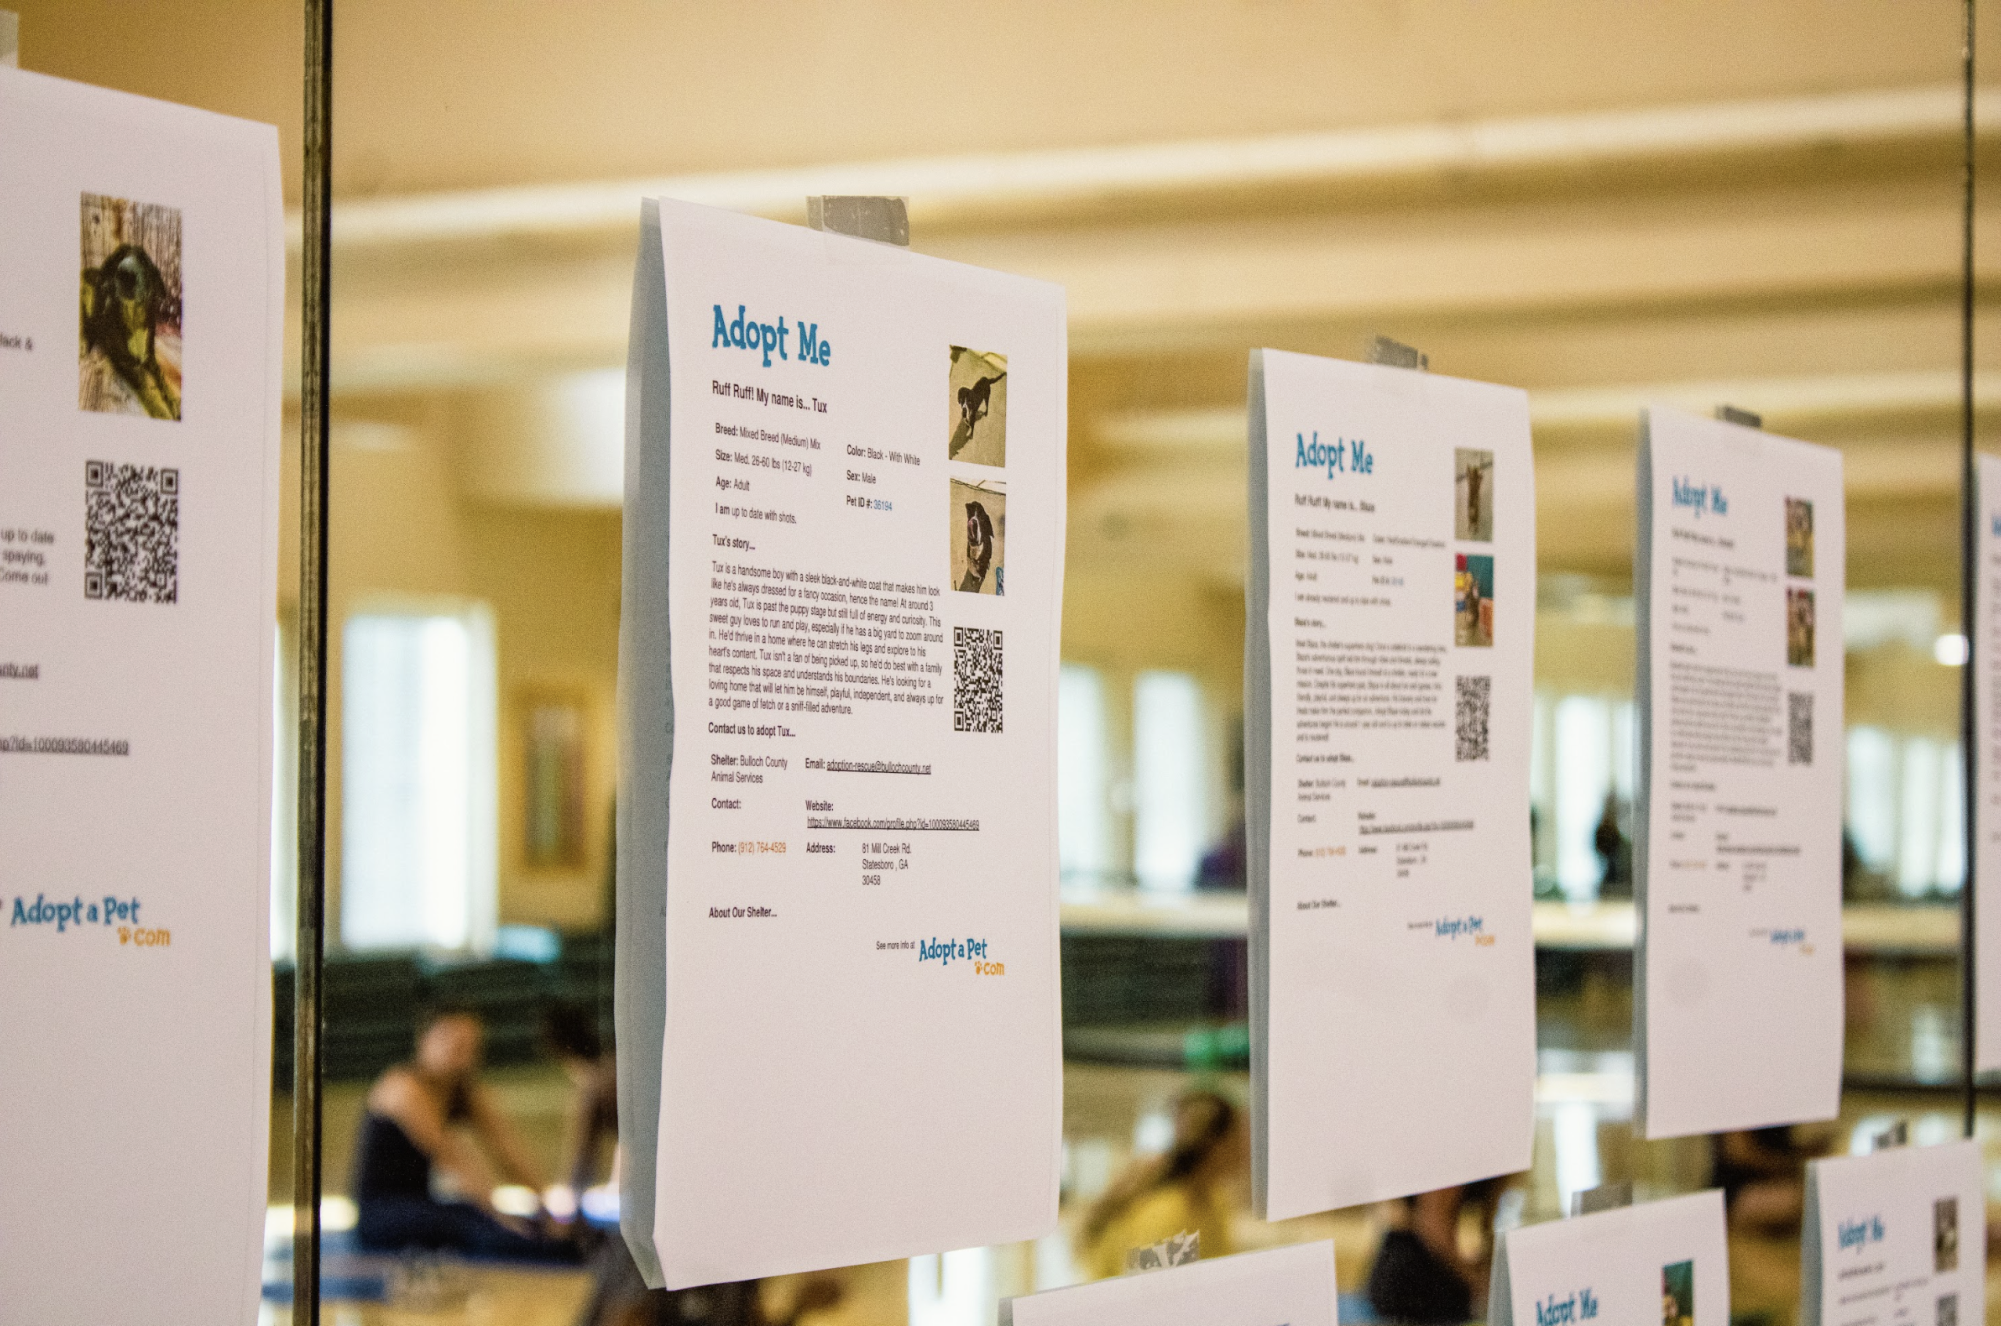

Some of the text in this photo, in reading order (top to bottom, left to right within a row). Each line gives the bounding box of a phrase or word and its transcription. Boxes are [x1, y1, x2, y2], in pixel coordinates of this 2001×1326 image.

[712, 305, 830, 367] Adopt Me
[713, 380, 827, 413] Ruff Ruff! My name is... Tux
[716, 422, 820, 450] Breed: Mixed Breed (Medium) Mix
[847, 444, 866, 457] Color:
[868, 448, 884, 460] Black
[889, 451, 902, 463] With
[904, 453, 920, 465] White
[1296, 431, 1373, 480] Adopt Me
[716, 449, 812, 477] Size: Med. 26-60 lbs (12-27 kg)
[716, 476, 749, 491] Age: Adult
[847, 470, 876, 484] Sex: Male
[847, 495, 892, 511] Pet ID #: 36194
[720, 505, 730, 515] am
[732, 508, 740, 518] up
[742, 508, 747, 517] to
[749, 507, 763, 519] date
[765, 510, 777, 521] with
[779, 511, 796, 524] shots.
[1, 528, 54, 544] up to date
[713, 534, 755, 552] Tux's story...
[32, 572, 48, 585] out
[712, 561, 940, 596] Tux is a handsome boy with a sleek black-and-white coat that makes him look
[711, 578, 933, 611] like he's always dressed for a fancy occasion, hence the name! At around 3
[710, 597, 941, 628] years old, Tux is past the puppy stage but still full of energy and curiosity. This
[708, 722, 796, 738] Contact us to adopt Tux...
[711, 754, 788, 770] Shelter: Bulloch County
[806, 758, 931, 774] Email: adoption-rescue@bullochcounty.net
[711, 771, 763, 783] Animal Services
[712, 798, 741, 809] Contact:
[805, 800, 833, 811] Website:
[712, 841, 786, 855] Phone: (912) 764-4529
[806, 842, 835, 853] Address:
[862, 843, 911, 854] 81 Mill Creek Rd.
[862, 859, 894, 870] Statesboro
[899, 859, 908, 869] GA
[862, 875, 880, 885] 30458
[11, 894, 140, 932] Adopt a Pet
[709, 906, 777, 918] About Our Shelter...
[1435, 916, 1461, 940] Adopt
[1469, 915, 1483, 934] Pet
[876, 941, 886, 950] See
[901, 941, 909, 949] info
[910, 941, 915, 949] at
[919, 938, 956, 965] Adopt
[958, 944, 964, 958] a
[967, 938, 987, 960] Pet
